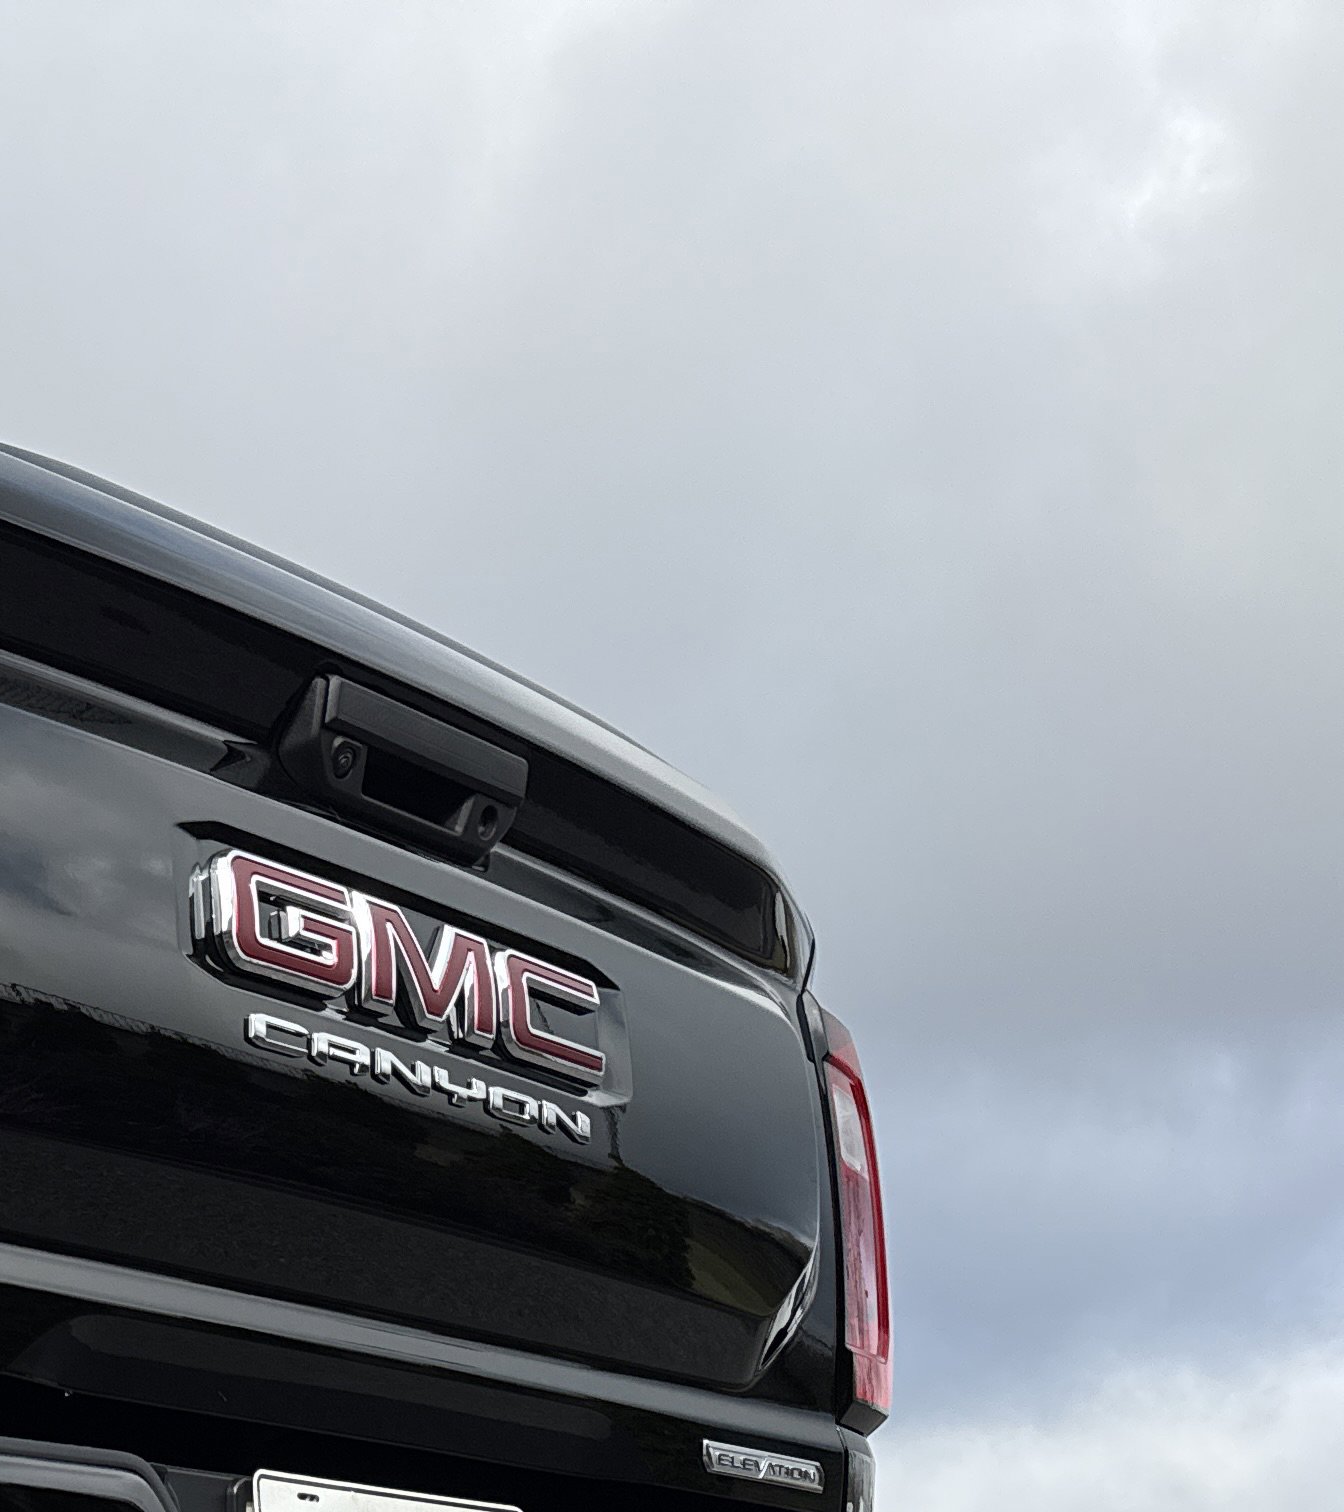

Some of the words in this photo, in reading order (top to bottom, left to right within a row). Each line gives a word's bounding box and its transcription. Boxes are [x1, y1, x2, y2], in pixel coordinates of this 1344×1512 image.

[192, 848, 606, 1086] GMC
[245, 1012, 592, 1144] CANYON
[716, 1451, 816, 1483] ELEVATION
